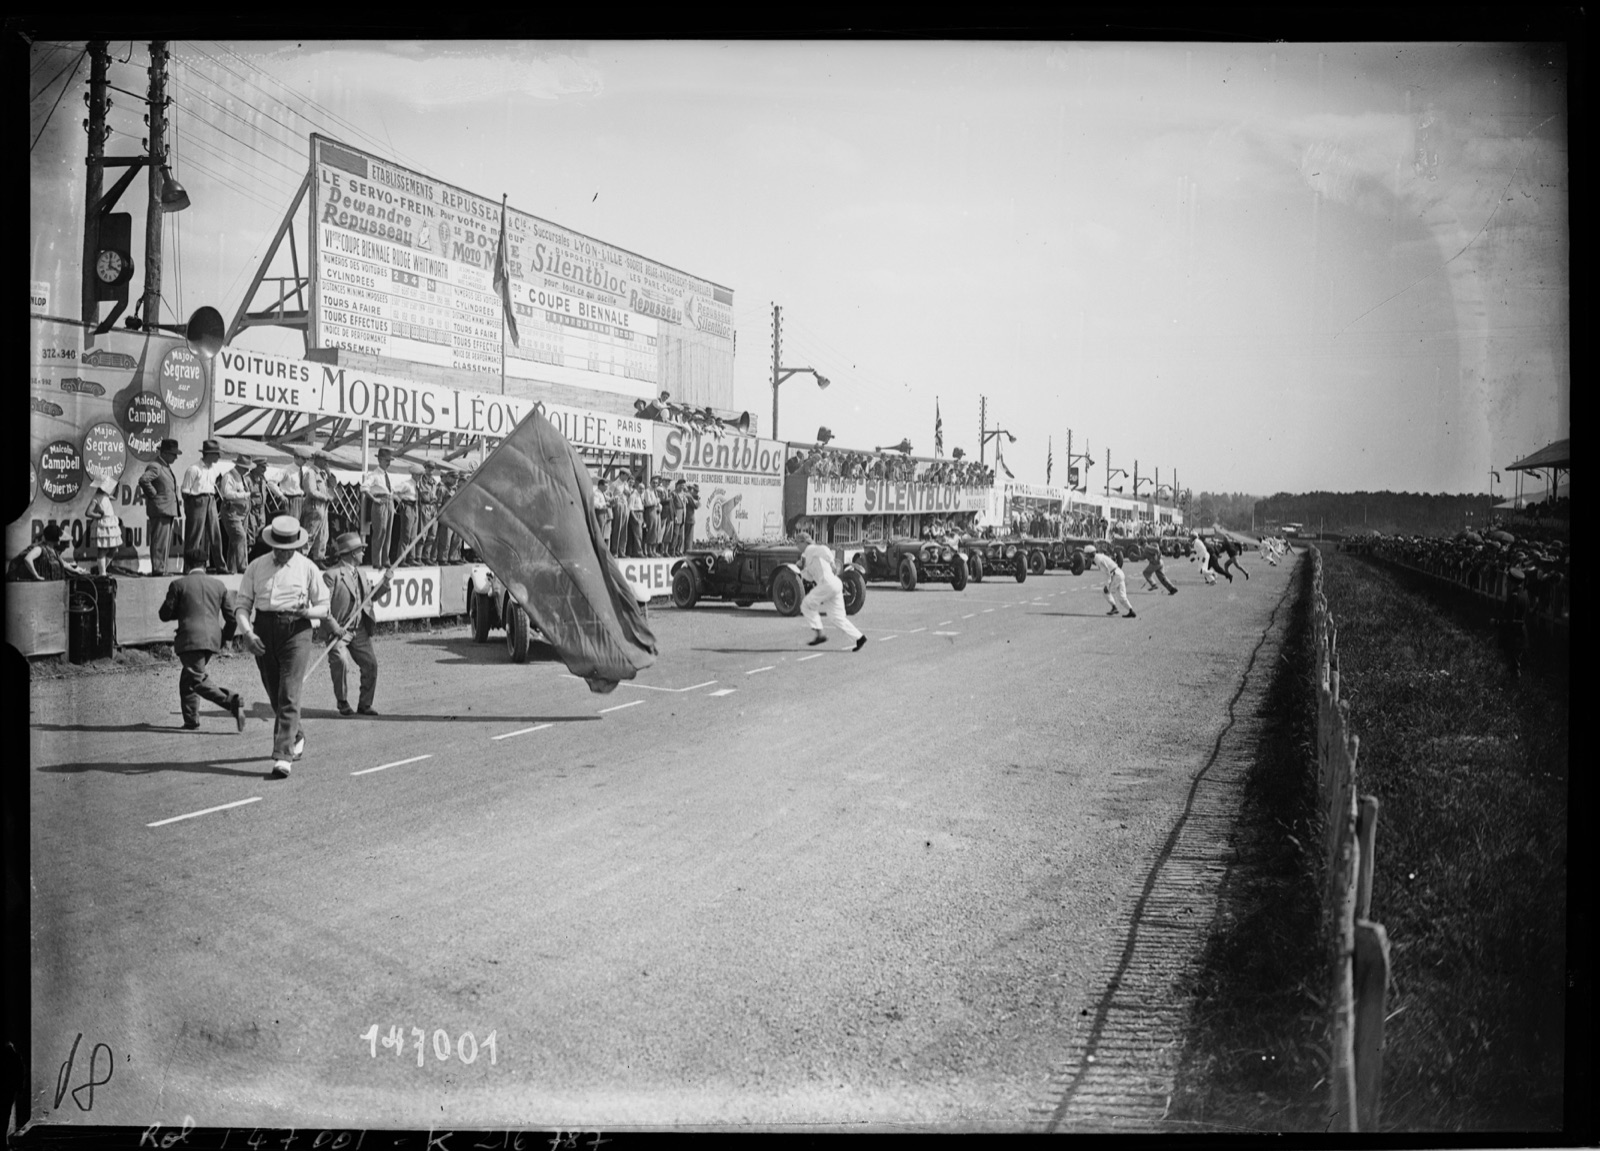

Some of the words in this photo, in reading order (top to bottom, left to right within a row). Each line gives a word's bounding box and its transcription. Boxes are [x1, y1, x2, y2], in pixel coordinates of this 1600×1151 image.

[322, 170, 340, 187] LE
[328, 186, 412, 228] Dewandre
[372, 165, 434, 200] ETABLISSEMENTS
[442, 190, 502, 224] REPUSSEA
[533, 224, 570, 248] Succursales
[321, 203, 413, 247] Repusseau
[457, 216, 487, 233] votre
[490, 227, 525, 244] moeur
[341, 233, 360, 256] COUPE
[361, 239, 390, 264] BIENNALE
[392, 247, 411, 270] RUDGE
[464, 230, 520, 258] BOYE
[349, 259, 360, 271] DES
[361, 263, 388, 278] VOITURES
[484, 250, 523, 276] MER
[530, 243, 627, 295] Silentbloc
[556, 247, 605, 270] DISPOSITIFS
[322, 281, 346, 296] DISTANCES
[543, 278, 559, 289] pour
[629, 272, 641, 284] LES
[323, 295, 349, 309] TOURS
[352, 302, 358, 311] A
[359, 303, 381, 315] FAIRE
[529, 288, 571, 313] COUPE
[578, 302, 629, 327] BIENNALE
[629, 289, 682, 324] Repusseau
[324, 309, 347, 324] TOURS
[349, 314, 388, 332] EFFECTUES
[696, 315, 731, 338] Silentbloc
[323, 324, 340, 337] INDICE
[341, 327, 349, 337] DE
[350, 328, 387, 345] PERFORMANCE
[453, 323, 472, 335] TOURS
[480, 328, 497, 340] FAIRE
[453, 336, 471, 348] TOURS
[171, 350, 195, 363] Major
[324, 338, 382, 356] CLASSEMENT
[163, 359, 200, 382] Segrave
[221, 351, 309, 382] VOITURES
[453, 361, 500, 375] CLASSEMENT
[178, 384, 191, 392] sur
[224, 378, 247, 398] DE
[256, 383, 299, 406] LUXE
[134, 395, 162, 409] Malcolm
[165, 389, 186, 410] Napier
[128, 407, 166, 426] Campbell
[534, 400, 607, 446] OLLÉE
[617, 419, 642, 434] PARIS
[94, 425, 117, 439] Major
[49, 444, 74, 456] Malcolm
[85, 437, 124, 456] Segrave
[127, 432, 152, 454] Campbell
[612, 437, 621, 447] LE
[624, 439, 647, 451] MANS
[660, 430, 781, 473] Silentbloc
[41, 454, 80, 473] Campbell
[43, 478, 66, 498] Napier
[864, 481, 961, 512] SILENTBLOC
[813, 497, 822, 512] EN
[847, 497, 854, 512] LE
[625, 564, 674, 589] SHEL
